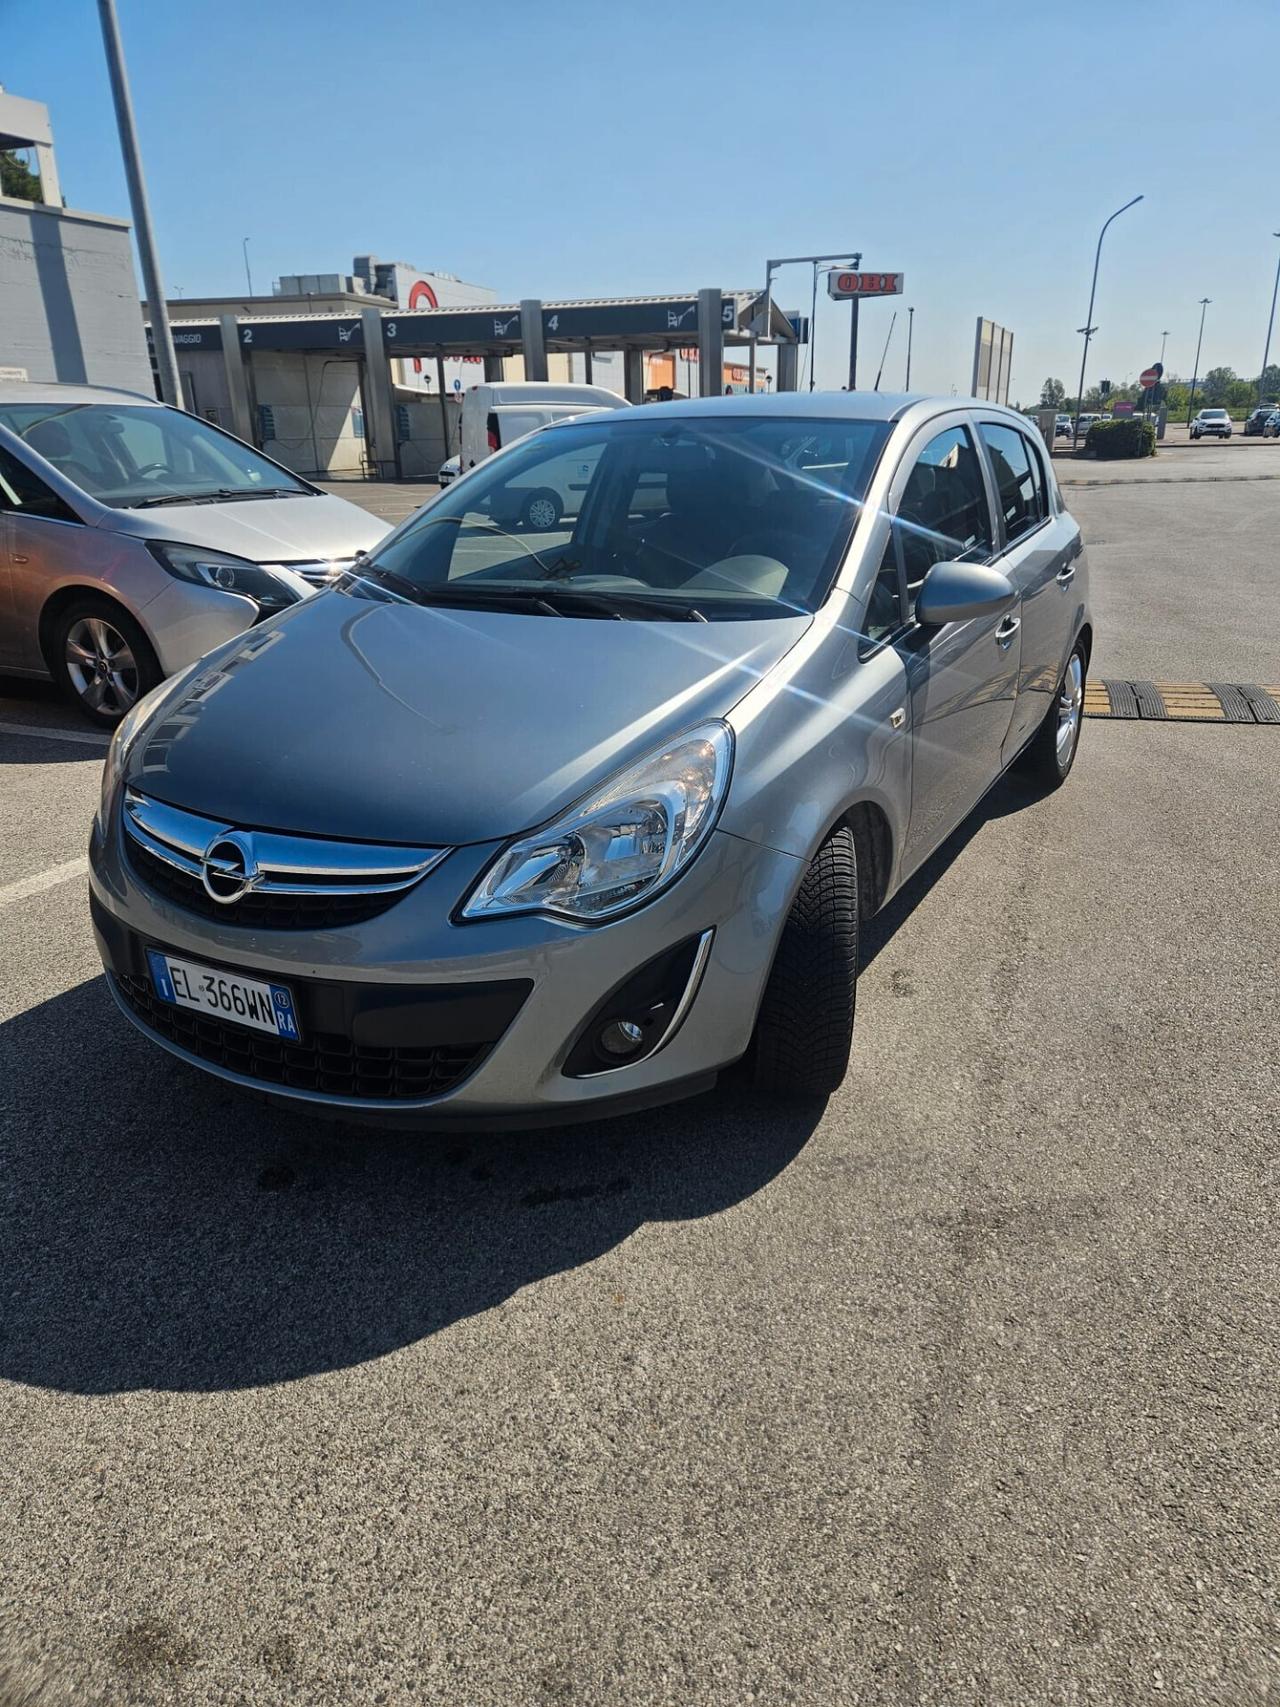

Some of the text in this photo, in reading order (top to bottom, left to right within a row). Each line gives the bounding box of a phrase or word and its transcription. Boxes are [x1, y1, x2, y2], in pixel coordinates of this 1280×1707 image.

[838, 273, 898, 292] OBI
[722, 306, 734, 322] 5
[387, 323, 397, 337] 3
[547, 315, 559, 331] 4
[243, 329, 253, 343] 2
[277, 1012, 295, 1032] RA
